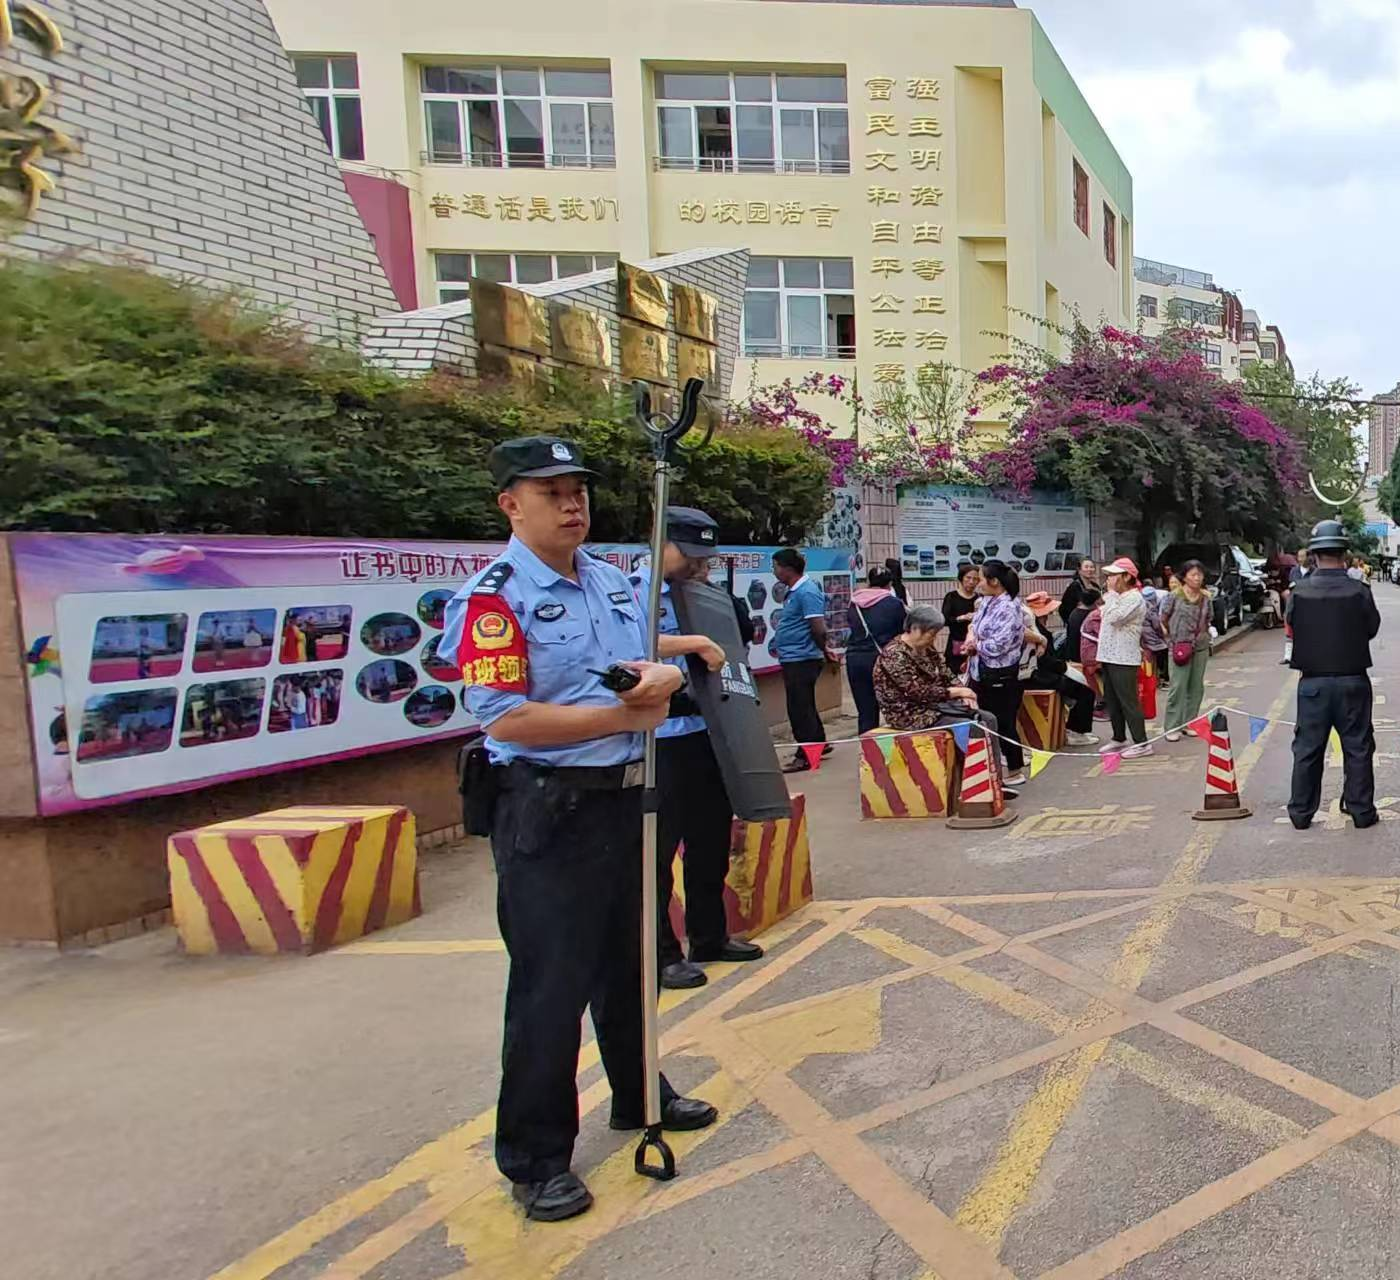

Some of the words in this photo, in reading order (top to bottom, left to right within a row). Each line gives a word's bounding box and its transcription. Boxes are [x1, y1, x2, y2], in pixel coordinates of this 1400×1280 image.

[429, 193, 620, 223] 普通话是我们
[678, 198, 840, 228] 的校园语言
